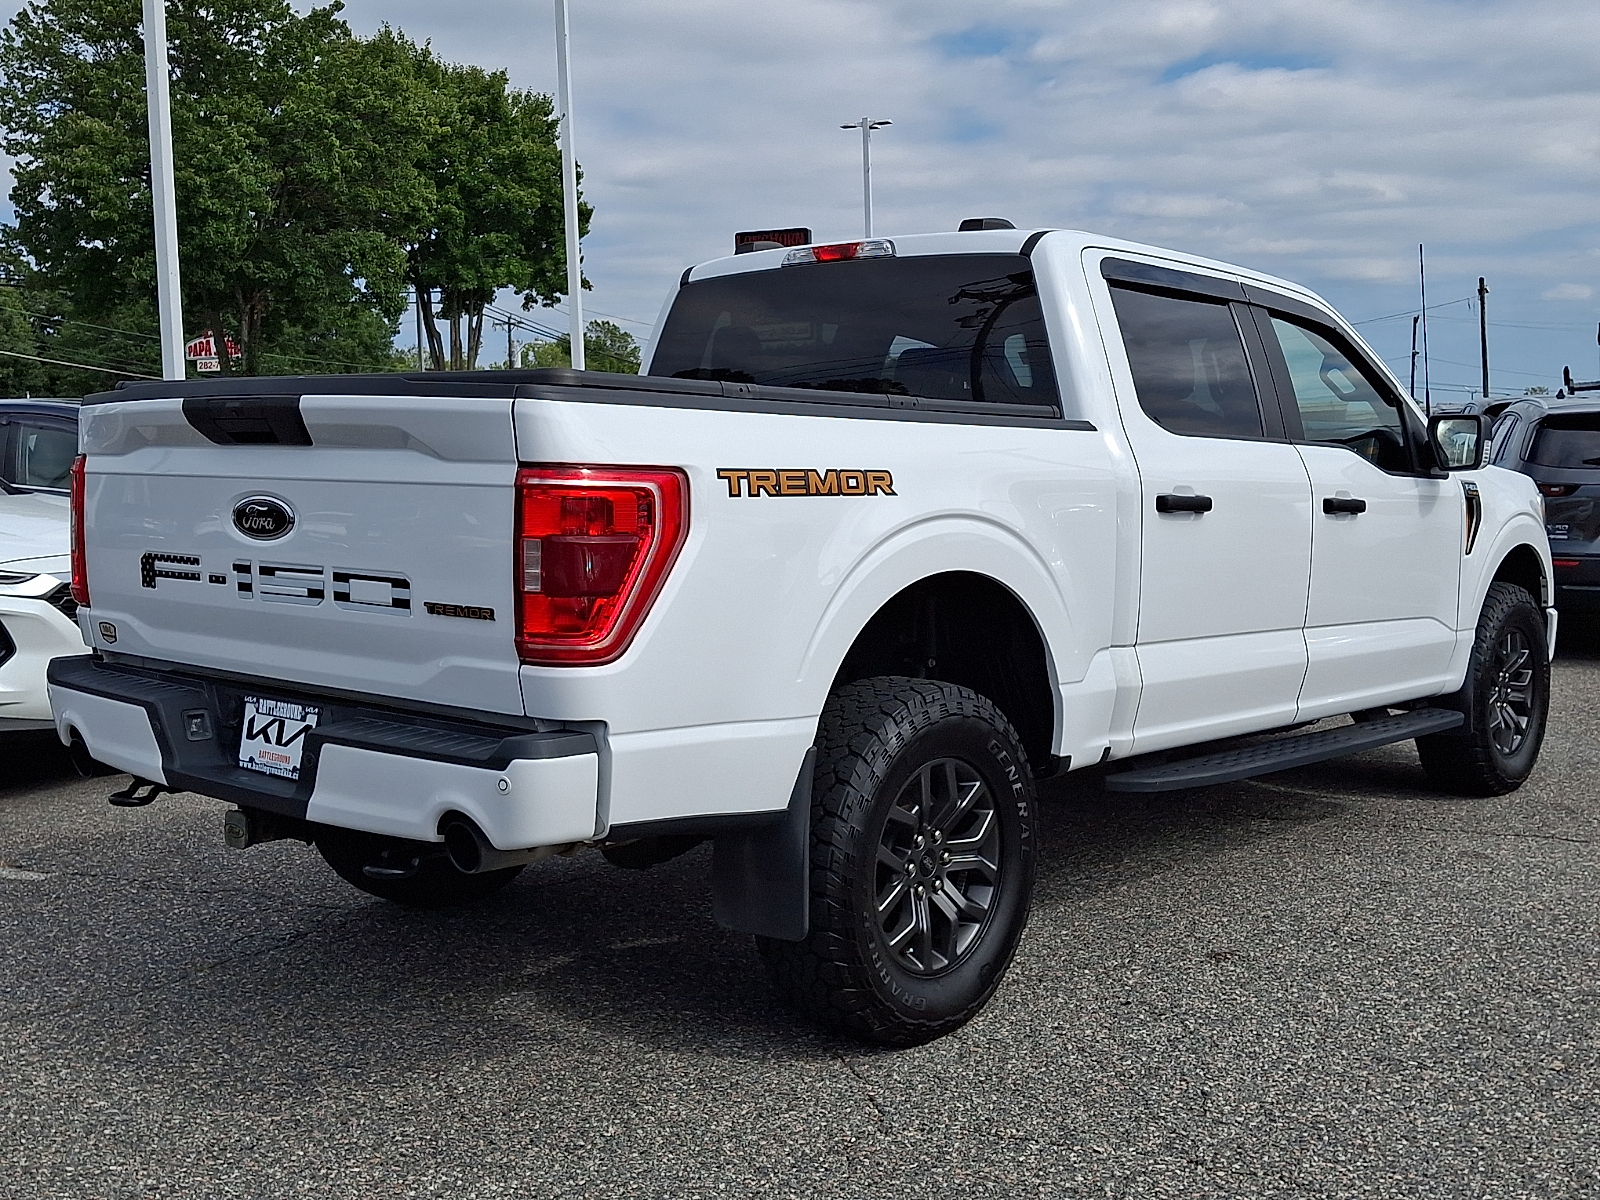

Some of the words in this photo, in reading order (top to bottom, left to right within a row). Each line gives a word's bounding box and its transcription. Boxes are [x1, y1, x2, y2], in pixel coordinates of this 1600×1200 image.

[187, 339, 213, 358] PAPA
[716, 468, 898, 497] TREMOR
[242, 504, 276, 530] Ford
[141, 551, 412, 617] F-150
[423, 601, 496, 622] TREMOR
[258, 698, 303, 720] BATTLEGROUND
[987, 739, 1030, 861] GENERAL
